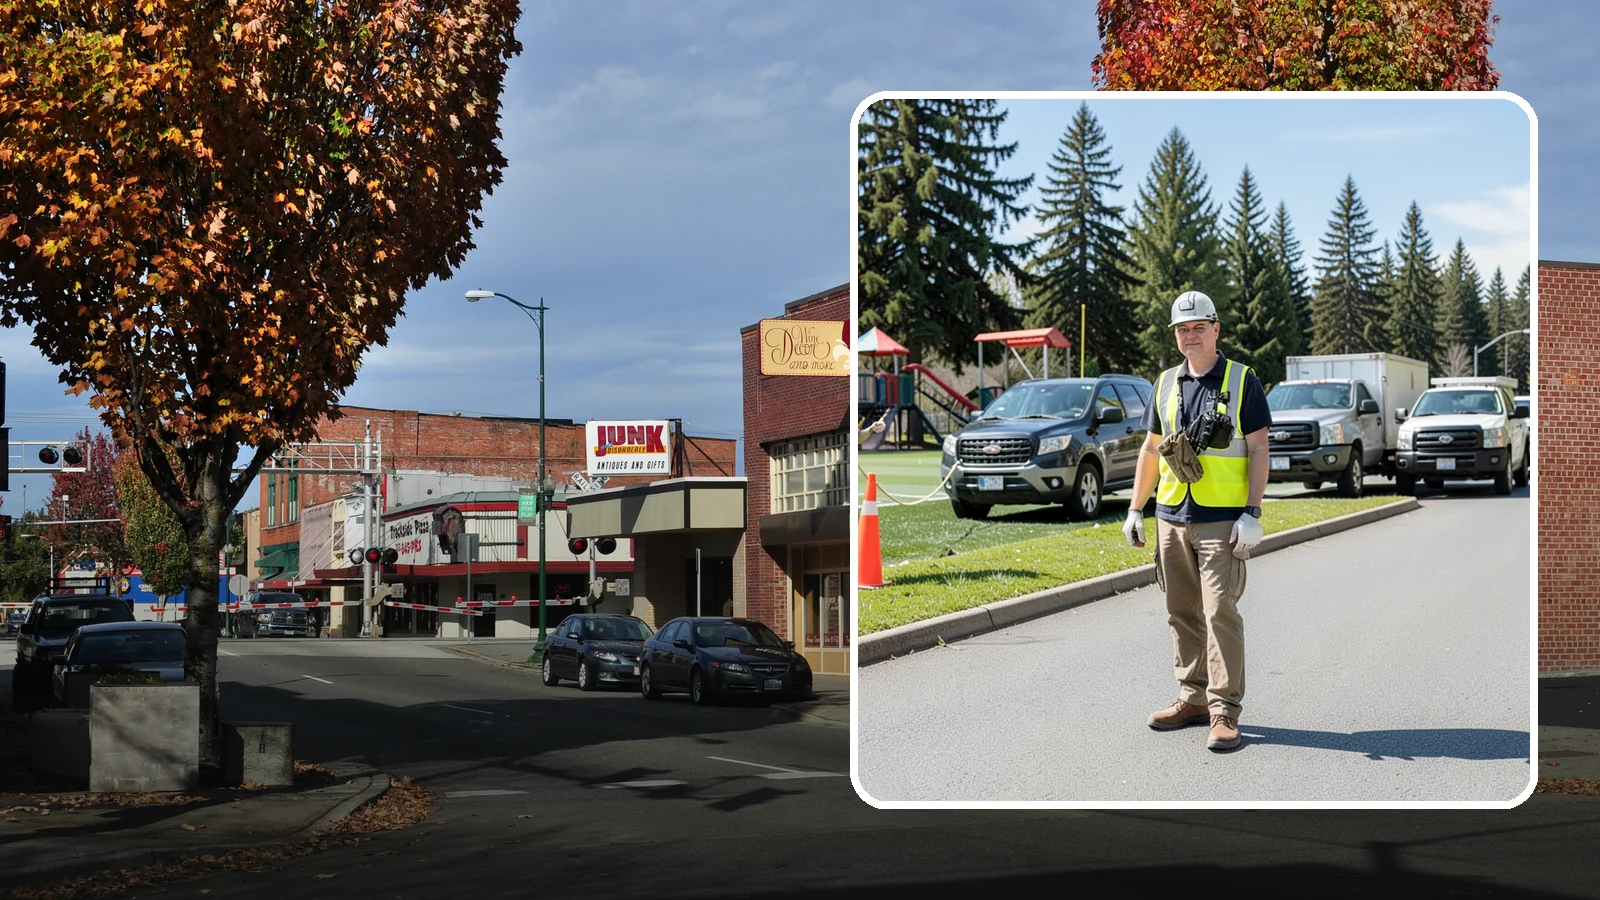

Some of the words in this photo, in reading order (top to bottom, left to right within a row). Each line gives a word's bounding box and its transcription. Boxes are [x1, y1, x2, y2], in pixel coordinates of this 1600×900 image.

[595, 425, 665, 457] JUNK
[607, 446, 646, 454] DISORDERLY
[597, 461, 628, 470] ANTIQUES
[631, 461, 644, 470] AND
[646, 461, 665, 470] GIFTS
[573, 473, 589, 490] RAIL
